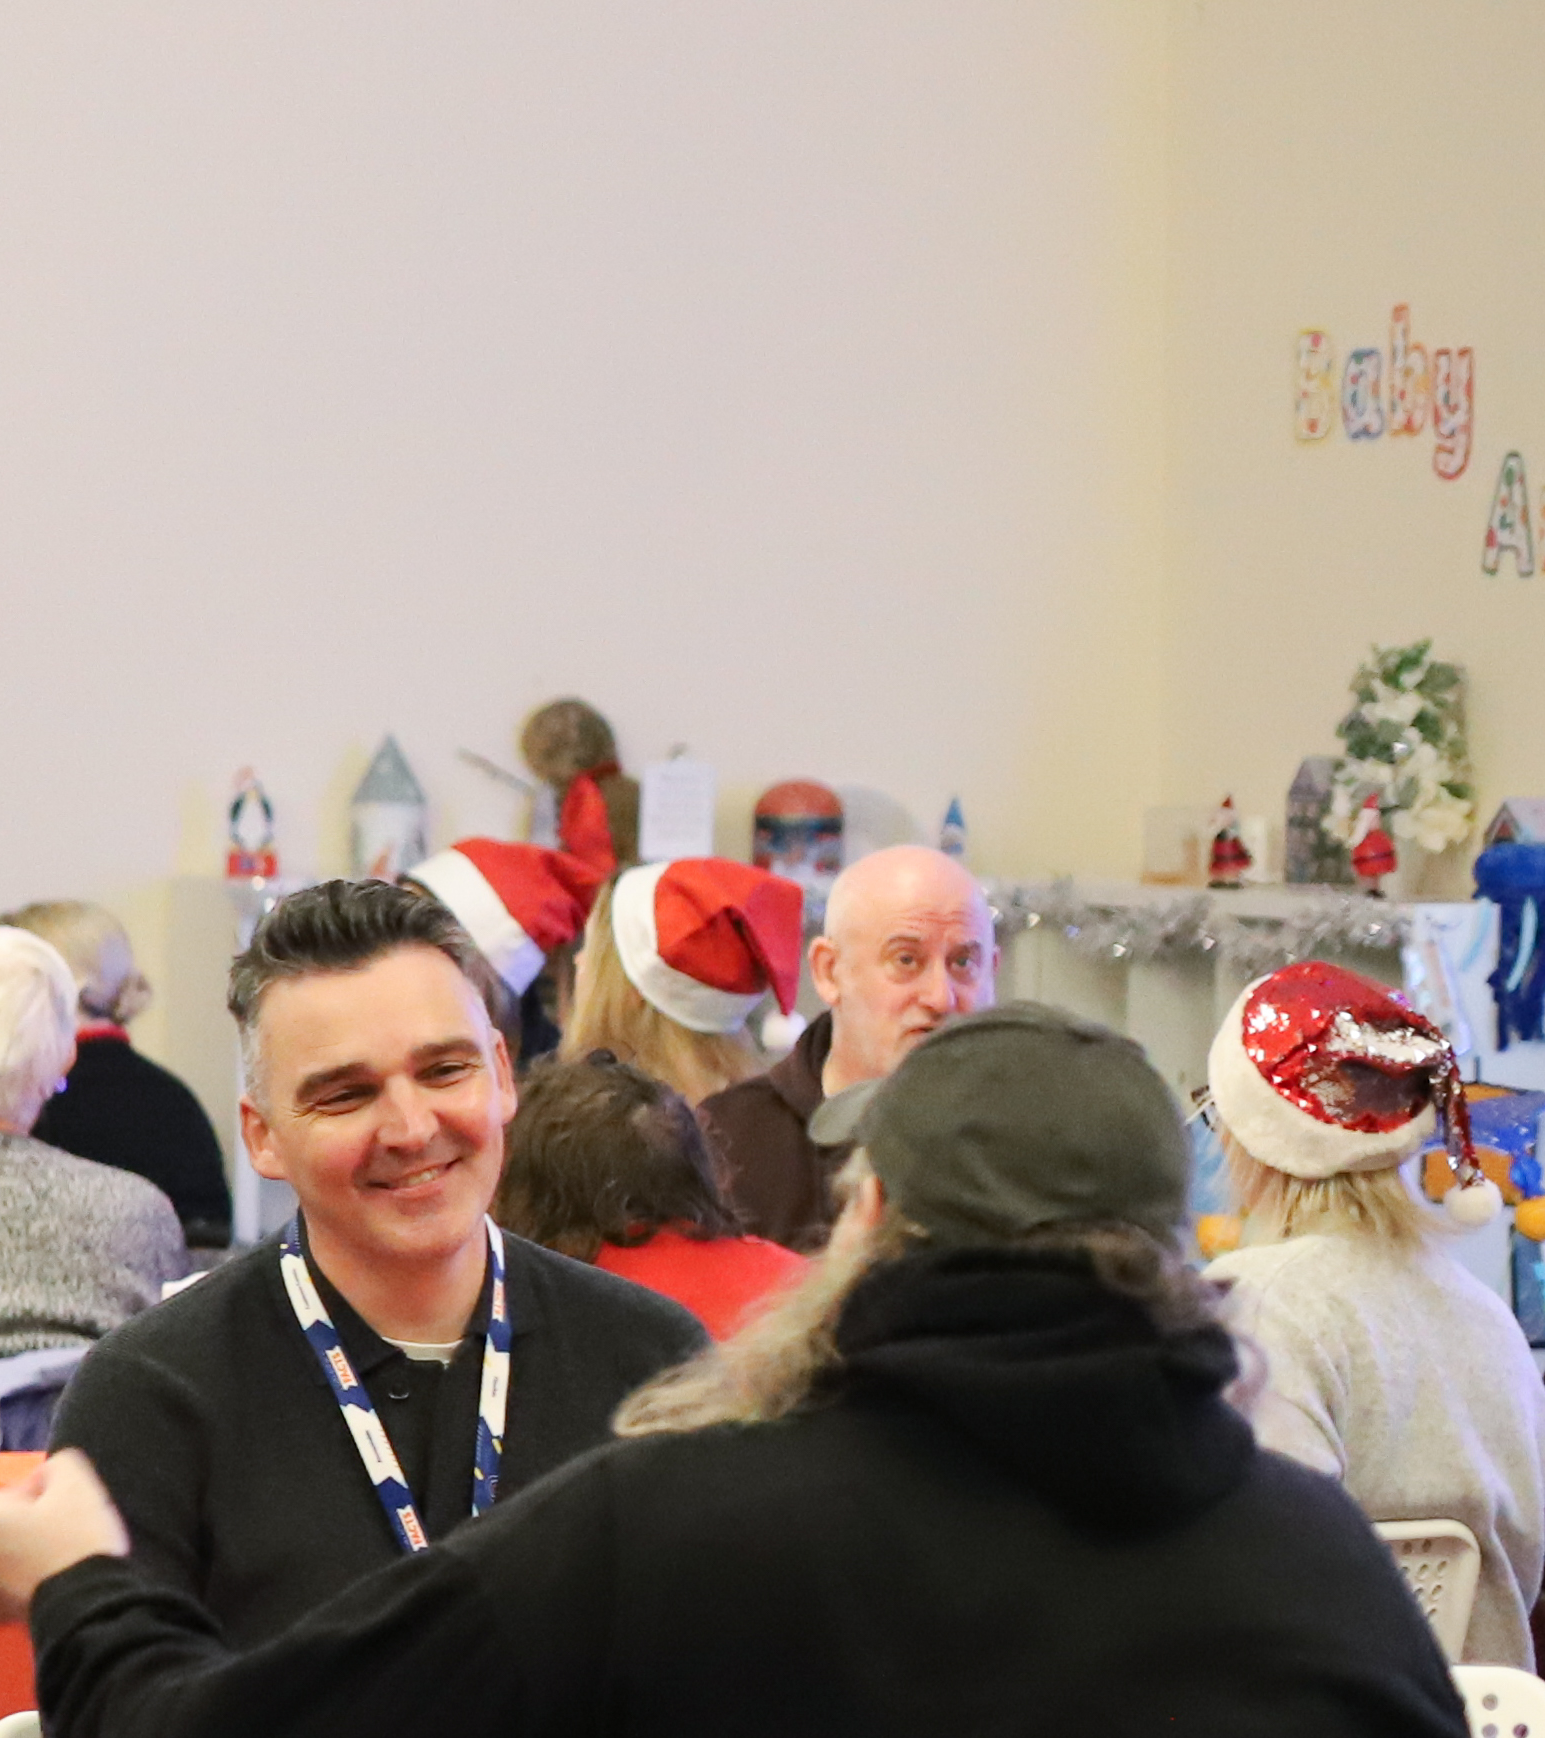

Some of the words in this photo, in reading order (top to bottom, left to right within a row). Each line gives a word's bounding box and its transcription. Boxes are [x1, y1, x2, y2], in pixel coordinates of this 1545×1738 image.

[1294, 303, 1477, 482] Baby
[332, 1351, 353, 1385] FACTS
[402, 1511, 423, 1546] FACTS
